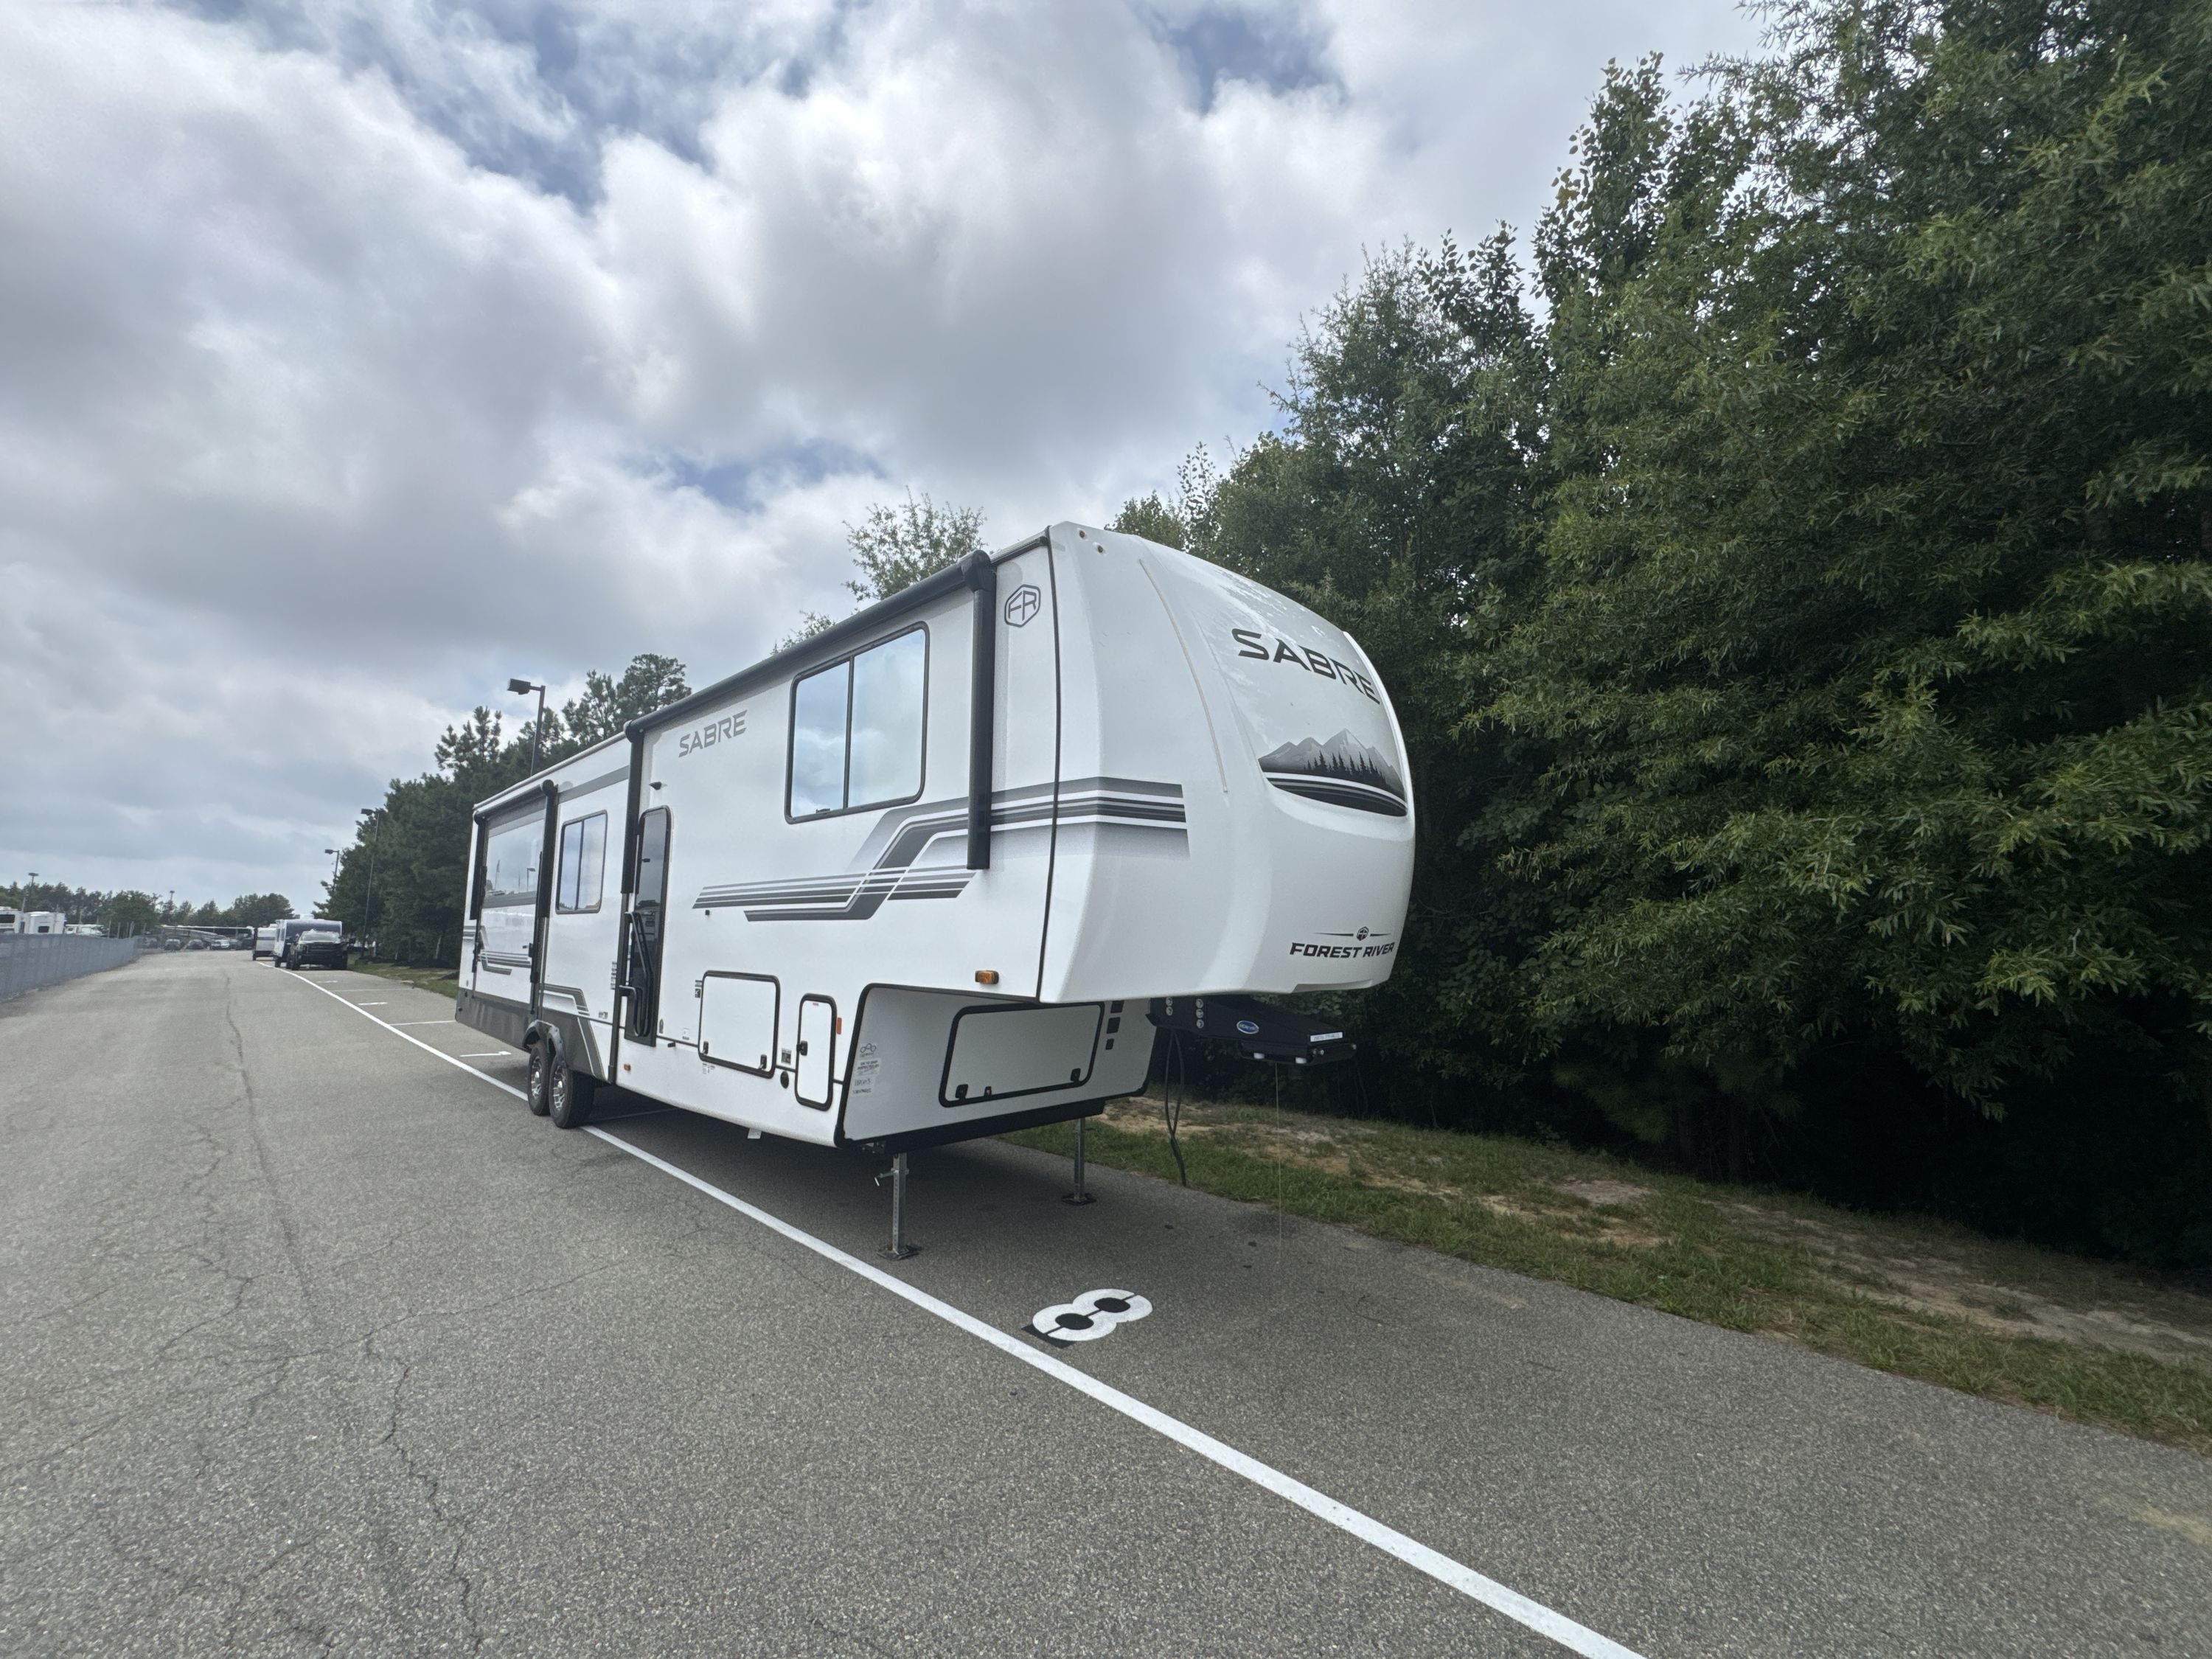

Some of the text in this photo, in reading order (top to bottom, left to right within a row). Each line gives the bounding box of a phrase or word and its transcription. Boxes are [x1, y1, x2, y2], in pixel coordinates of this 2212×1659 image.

[1231, 628, 1380, 705] SABRE
[678, 709, 748, 758] SABRE
[1290, 942, 1395, 959] FOREST RIVER
[1032, 1288, 1153, 1341] 8
